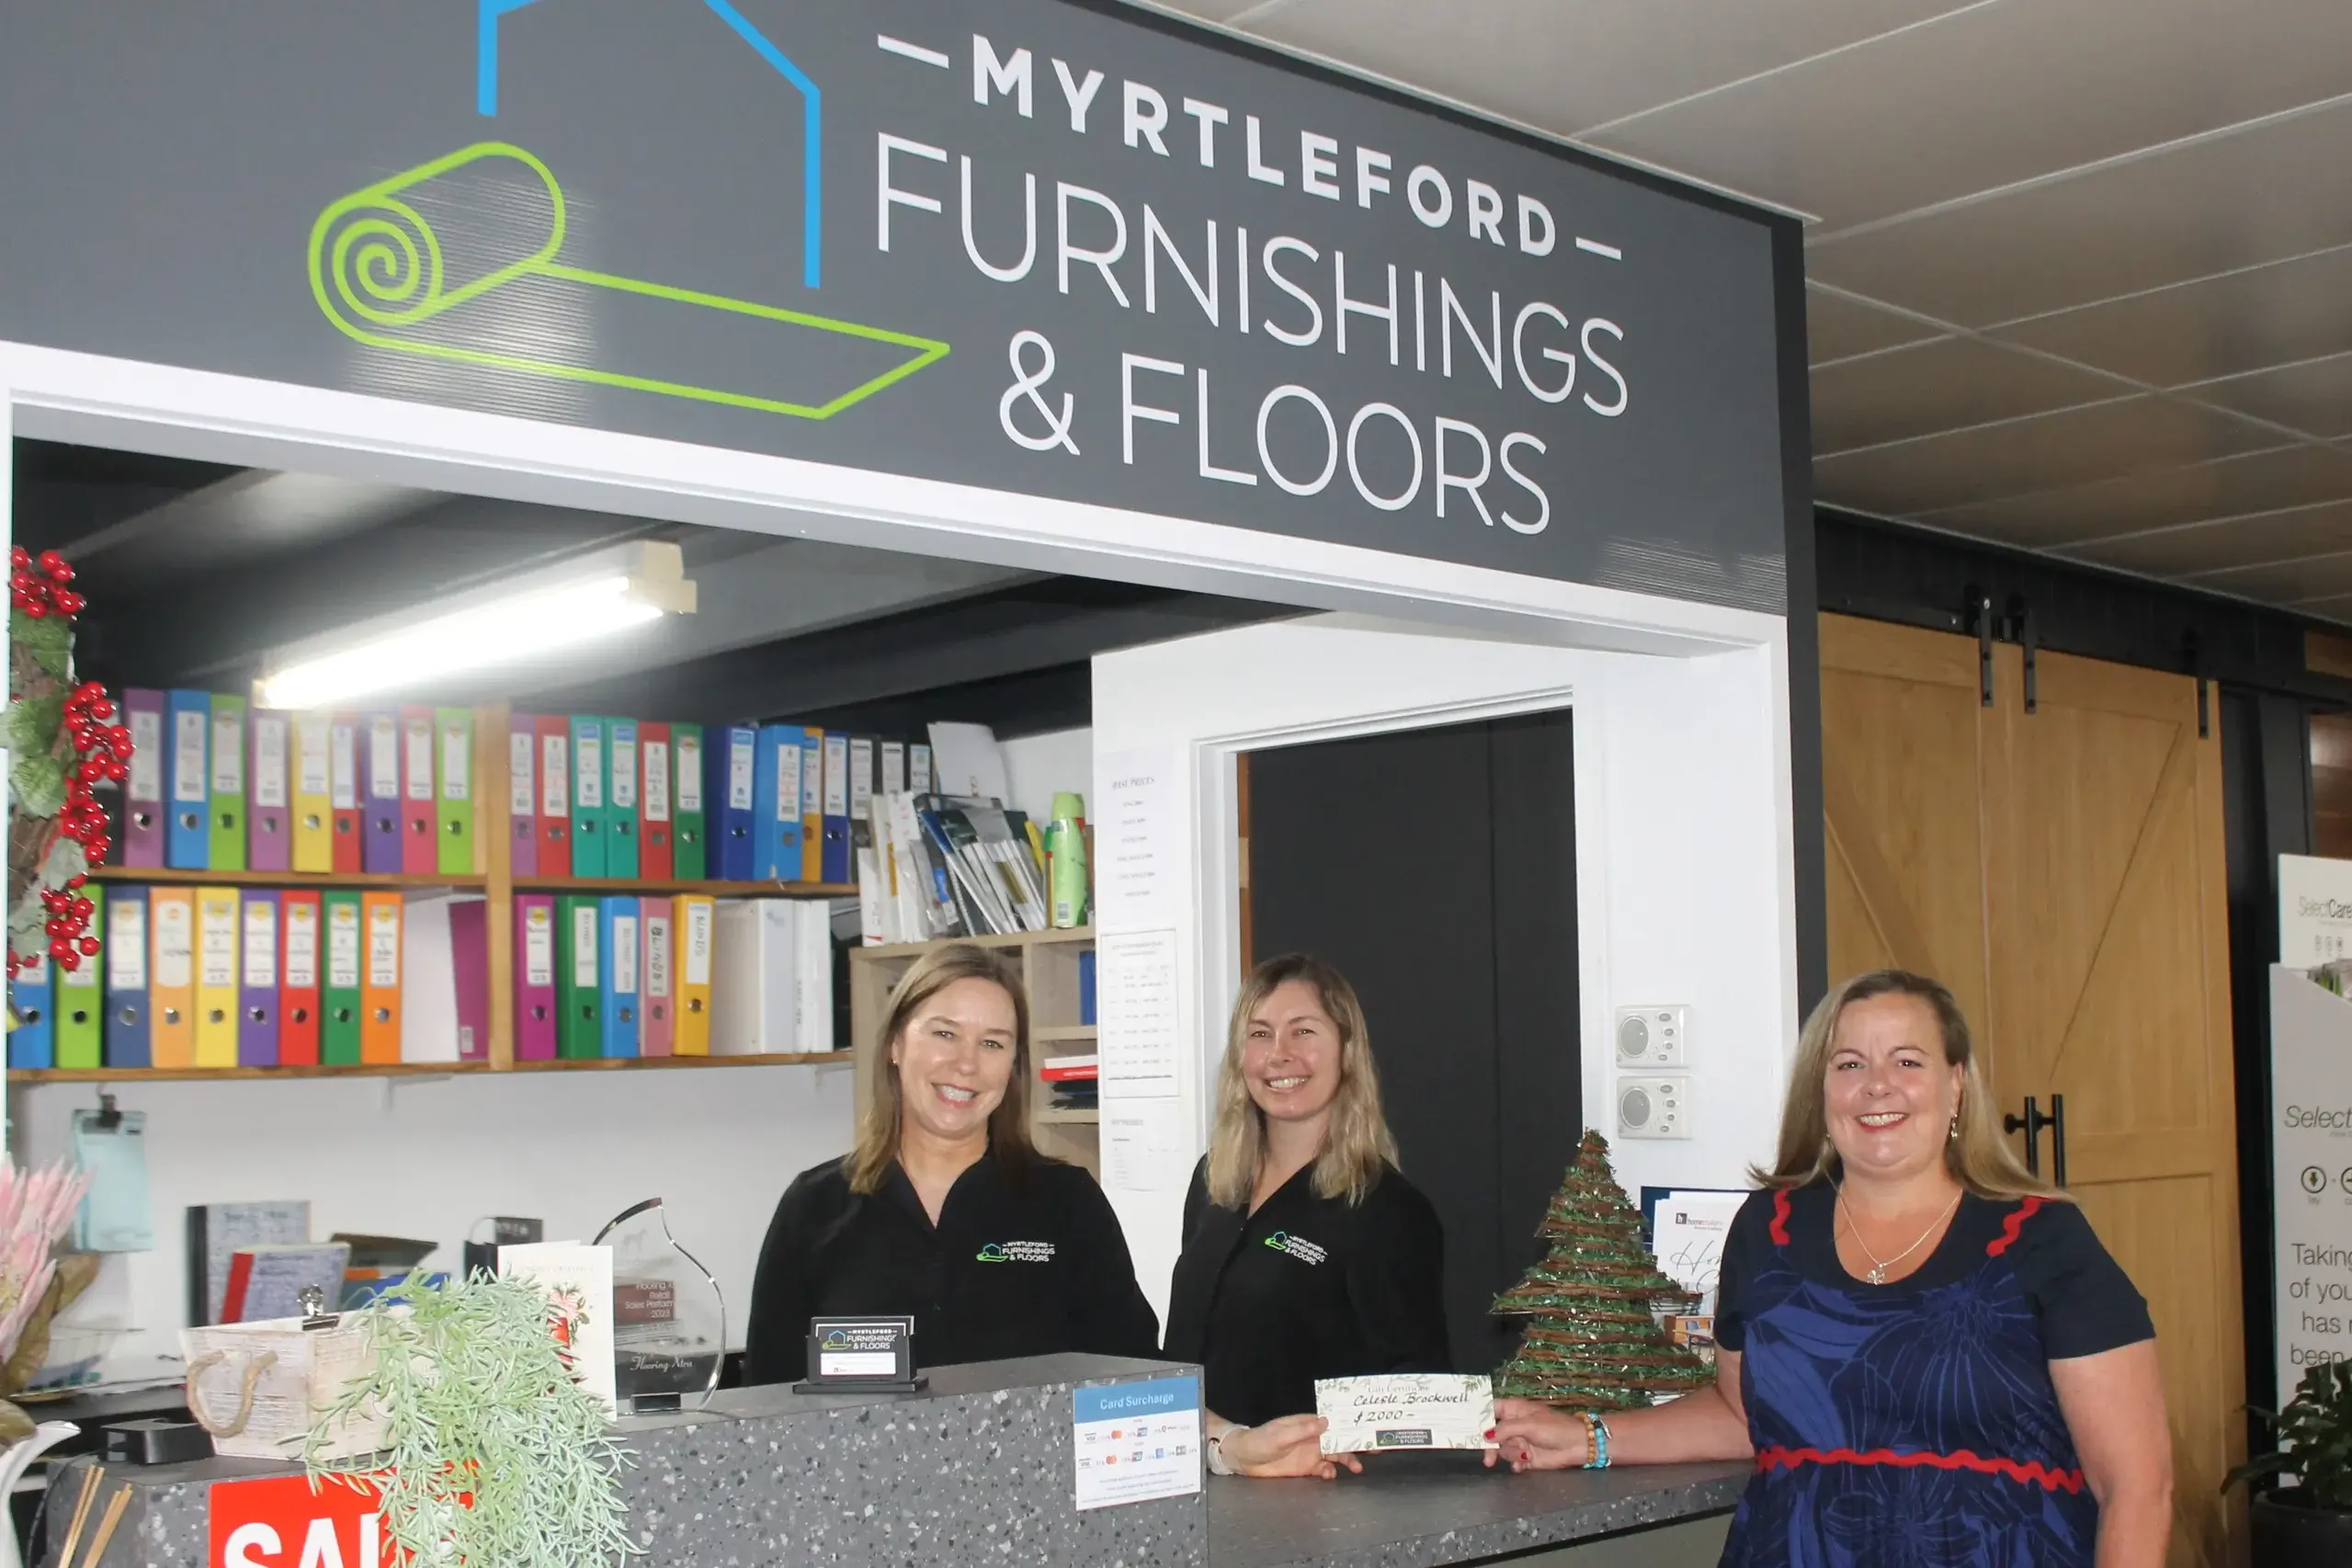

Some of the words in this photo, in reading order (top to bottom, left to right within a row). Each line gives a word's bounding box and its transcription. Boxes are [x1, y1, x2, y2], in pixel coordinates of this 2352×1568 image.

[972, 34, 1556, 258] MYRTLEFORD
[878, 132, 1628, 417] FURNISHINGS
[999, 330, 1081, 456] &
[1122, 352, 1551, 536] FLOORS
[1002, 1247, 1055, 1256] FURNISHINGS
[1017, 1254, 1050, 1263] FLOORS
[2290, 1278, 2311, 1298] of
[2302, 1311, 2341, 1334] has
[860, 1342, 891, 1350] FLOORS
[1100, 1397, 1124, 1410] Card
[1125, 1393, 1175, 1405] Surcharge
